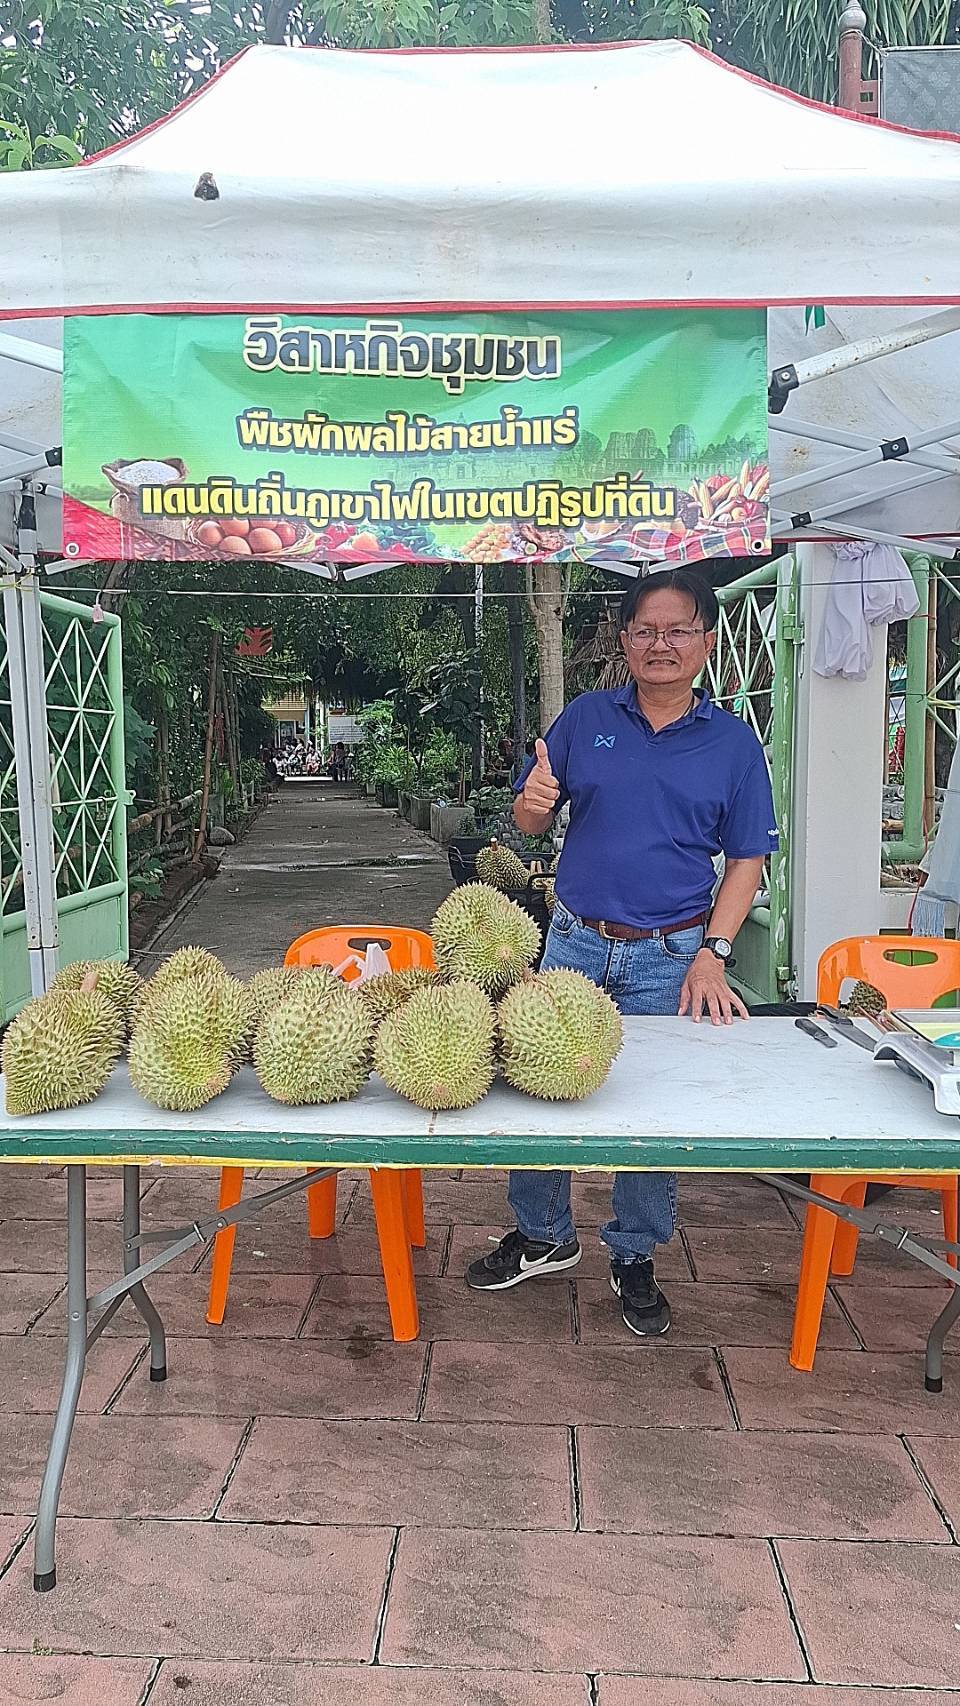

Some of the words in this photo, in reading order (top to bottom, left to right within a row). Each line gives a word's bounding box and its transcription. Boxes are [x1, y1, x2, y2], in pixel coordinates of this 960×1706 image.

[244, 318, 560, 391] วิสาหกิจชุมชน
[238, 406, 578, 453] พืชผักผลไม้สายน้ำแร่
[140, 473, 675, 528] แดนดินถิ่นภูเขาไฟในเขตปฏิรูปที่ดิน
